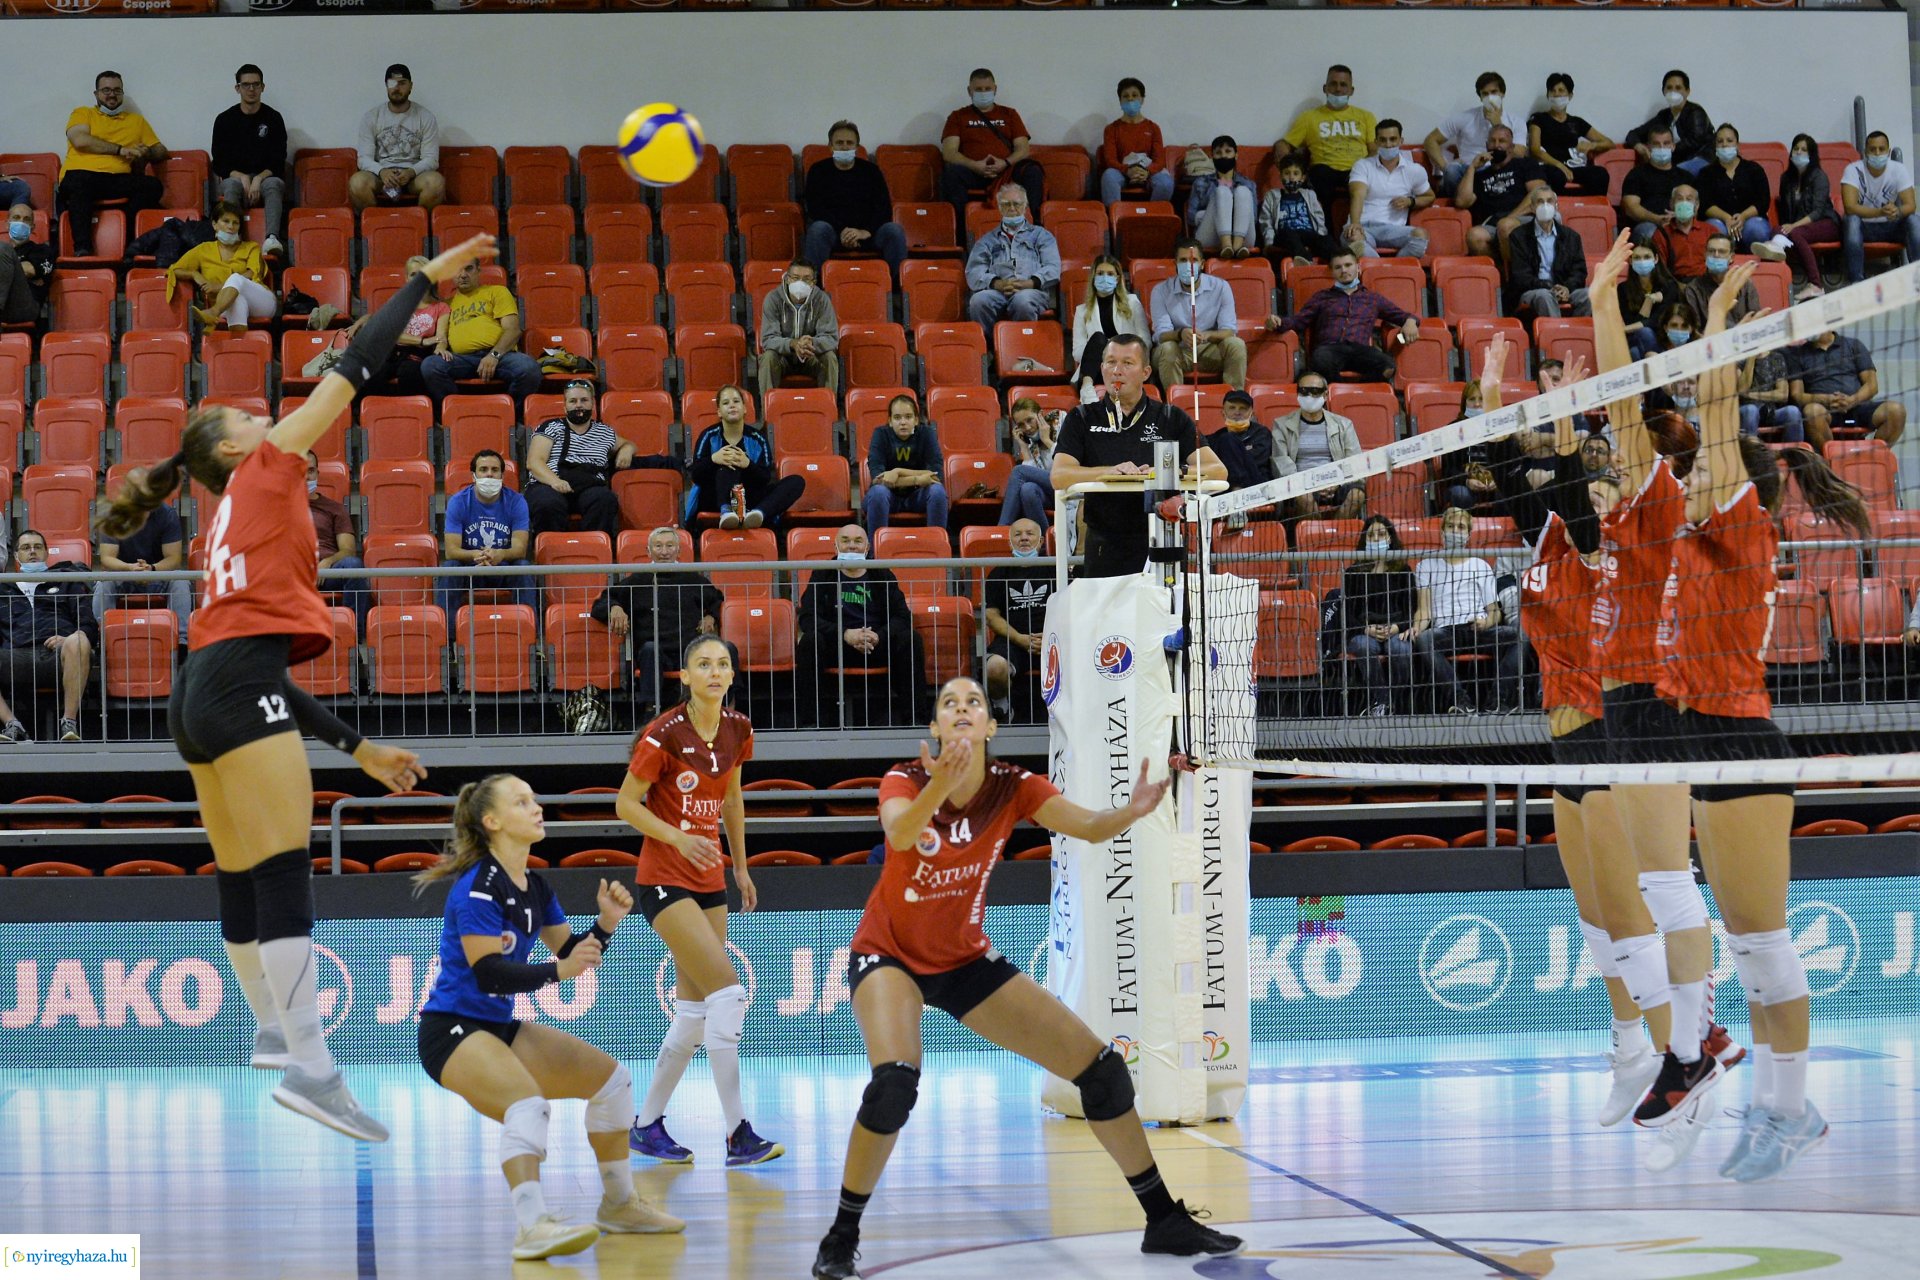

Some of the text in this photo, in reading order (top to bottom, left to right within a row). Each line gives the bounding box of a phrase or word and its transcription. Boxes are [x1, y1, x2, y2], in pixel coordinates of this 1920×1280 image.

[1319, 121, 1361, 137] SAIL
[896, 446, 911, 462] W
[257, 693, 290, 724] 12
[709, 751, 719, 773] 1
[949, 817, 973, 844] 14
[654, 885, 668, 900] 1
[1, 957, 223, 1029] JAKO
